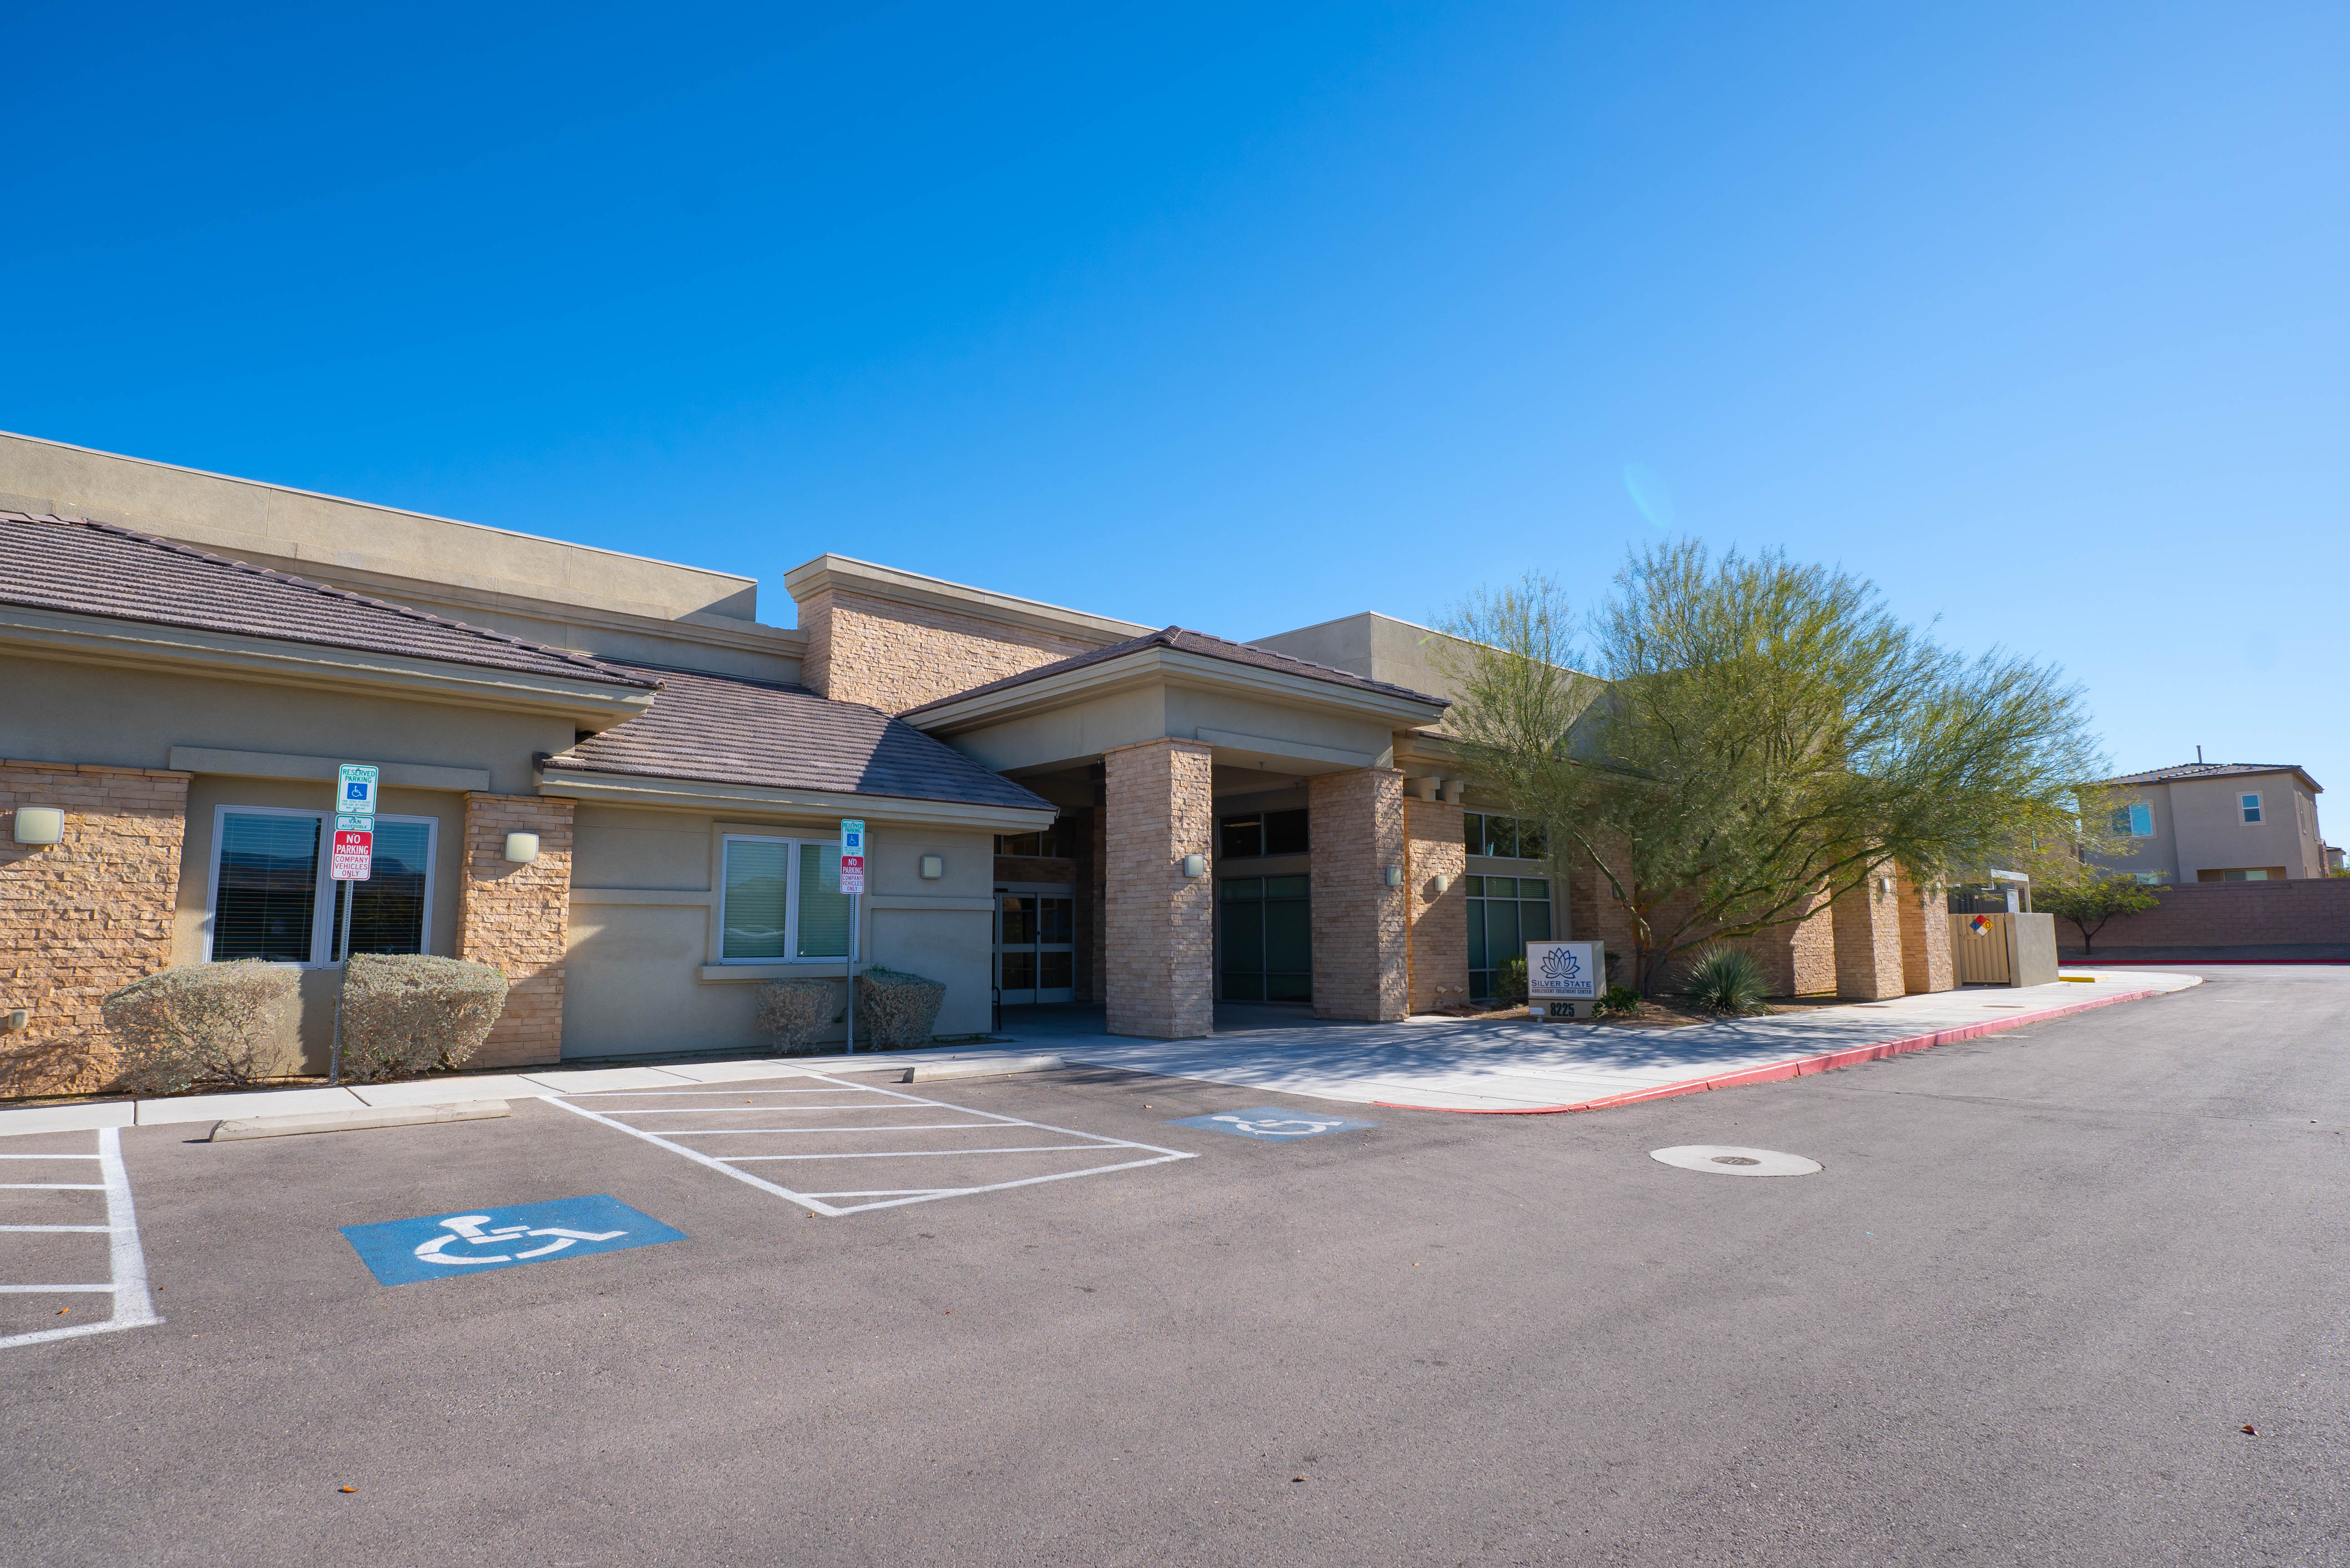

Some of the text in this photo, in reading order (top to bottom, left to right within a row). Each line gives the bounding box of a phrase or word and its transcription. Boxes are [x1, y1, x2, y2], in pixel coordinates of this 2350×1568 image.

[342, 769, 375, 777] RESERVED
[346, 834, 361, 844] NO
[336, 844, 369, 855] PARKING
[843, 866, 863, 874] PARKING
[1550, 1002, 1575, 1017] 8225
